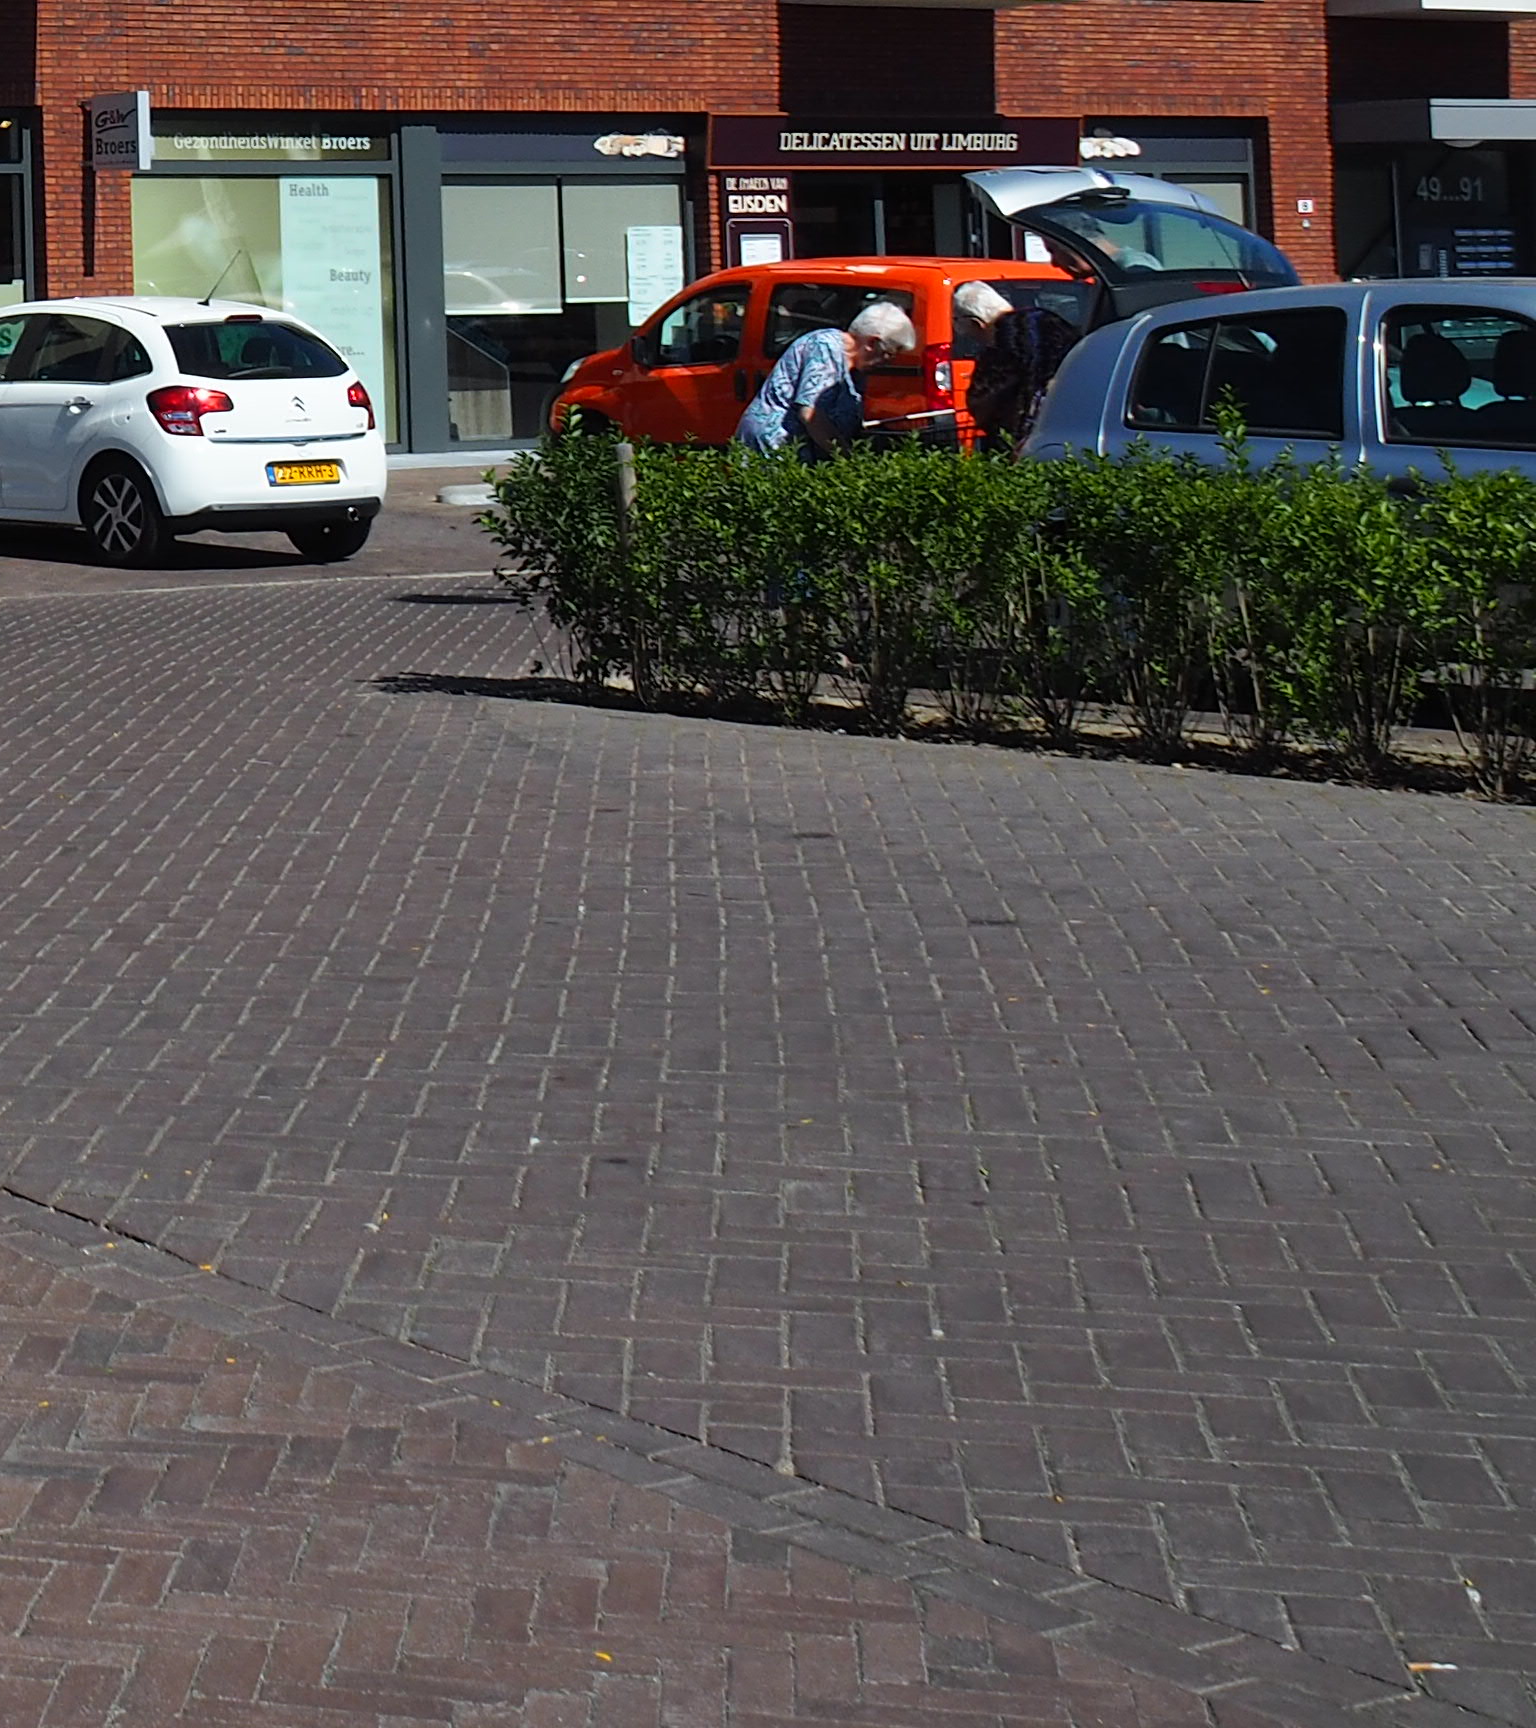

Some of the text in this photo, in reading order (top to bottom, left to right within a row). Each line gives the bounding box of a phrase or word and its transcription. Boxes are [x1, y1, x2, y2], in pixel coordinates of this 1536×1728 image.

[96, 138, 137, 154] Broers
[174, 132, 371, 150] GezondheidsWinkel Broers
[780, 133, 1019, 151] DELICATESSEN UIT LIMBURG
[289, 183, 329, 197] Health
[329, 269, 371, 284] Beauty
